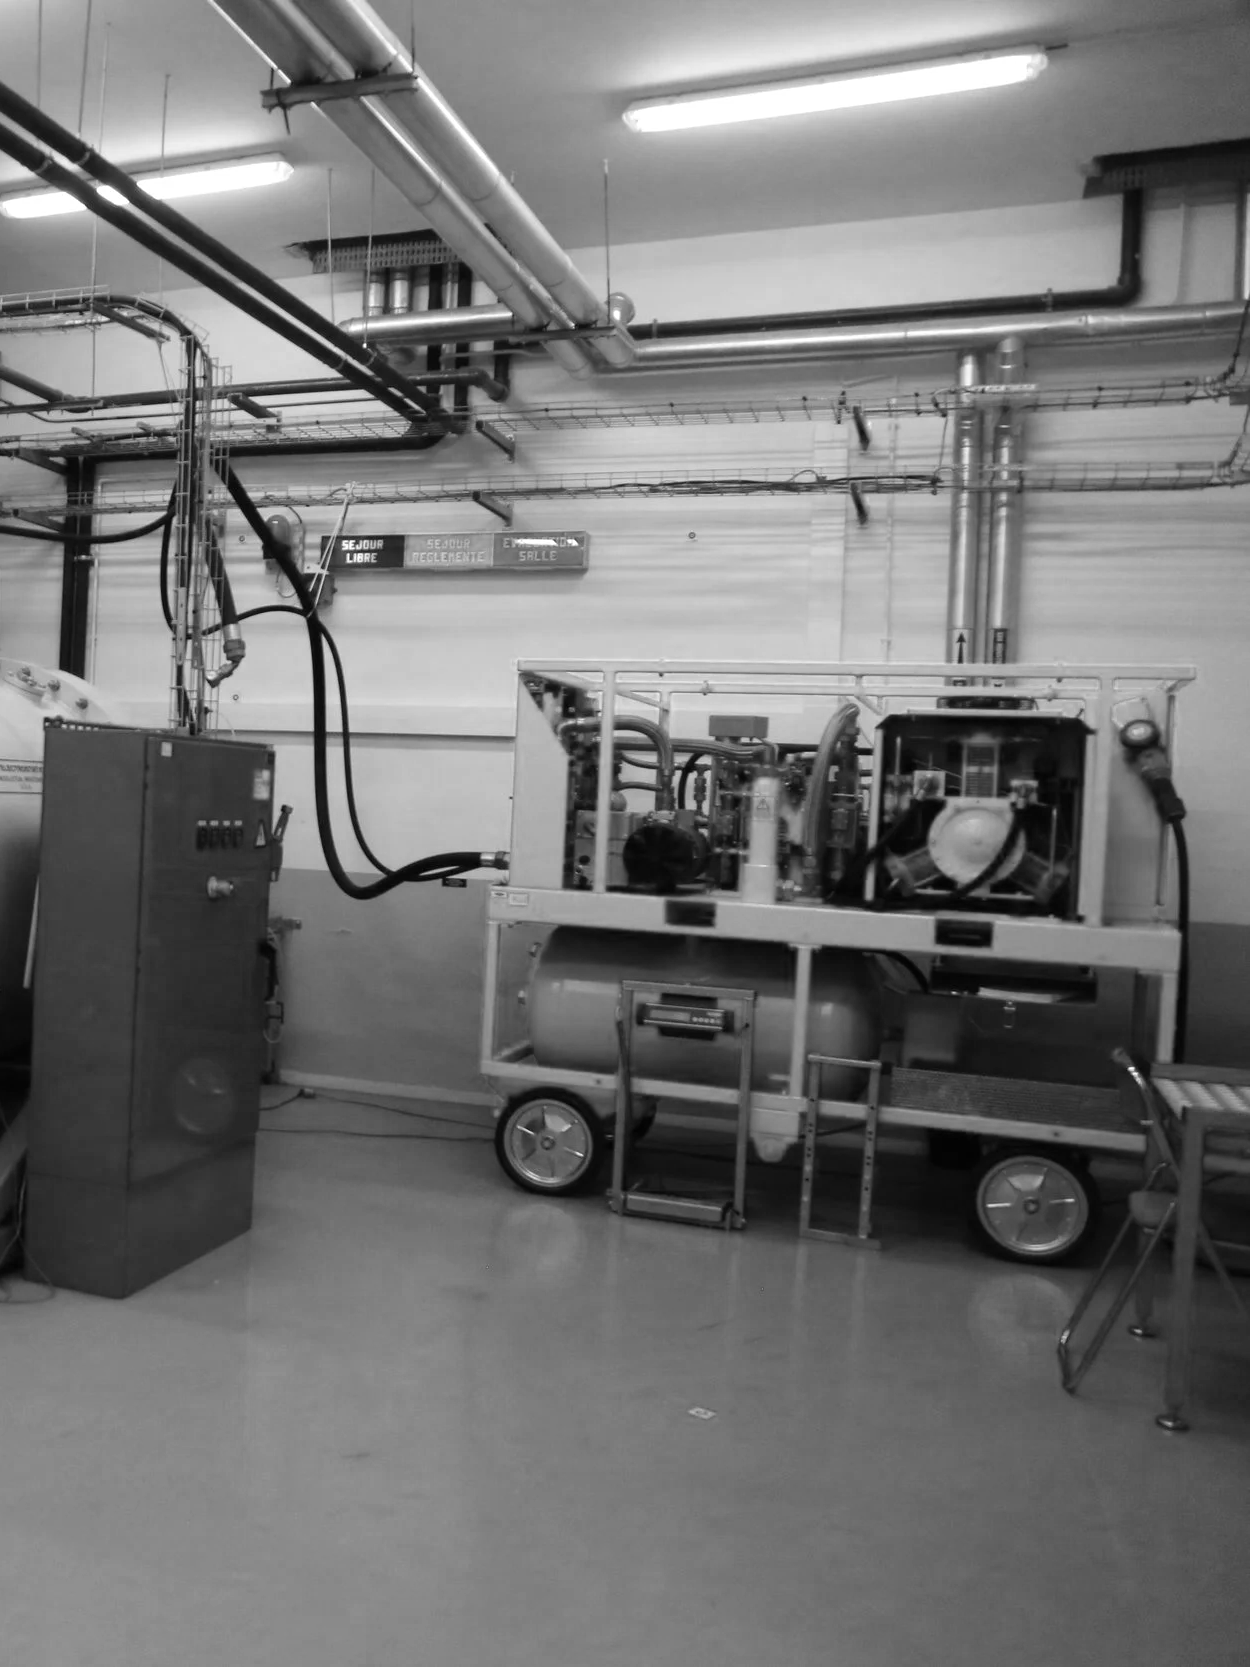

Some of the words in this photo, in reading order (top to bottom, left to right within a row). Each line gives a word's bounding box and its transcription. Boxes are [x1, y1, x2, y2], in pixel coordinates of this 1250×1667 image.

[341, 540, 384, 551] SEJOUR
[426, 538, 470, 549] SEJOUR
[346, 553, 378, 563] LIBRE
[518, 550, 558, 562] SALLE
